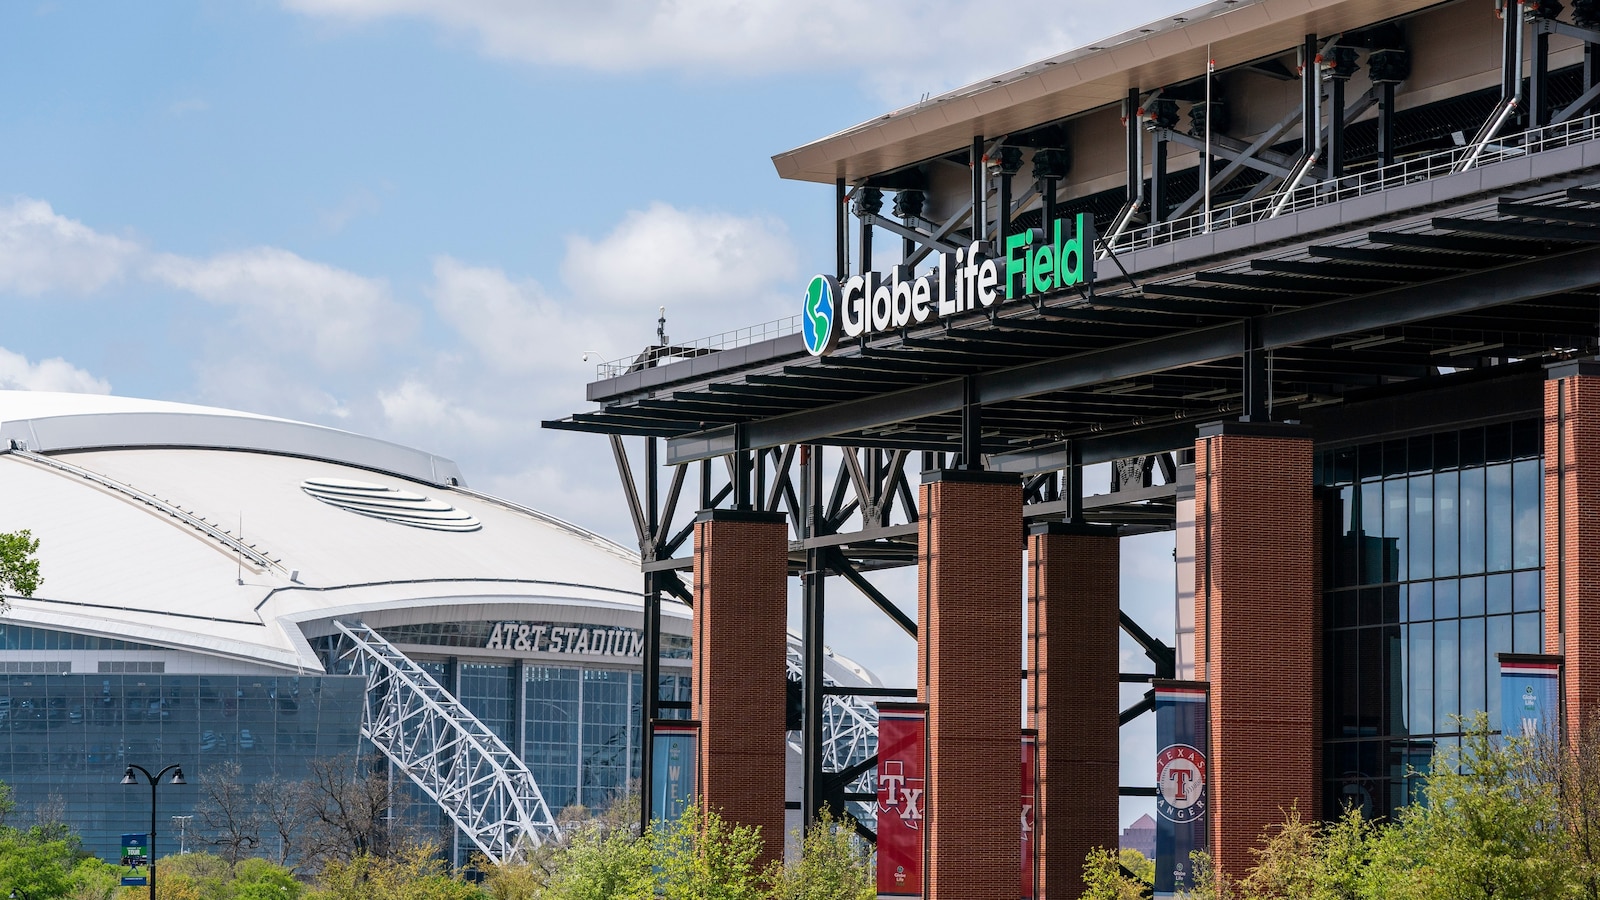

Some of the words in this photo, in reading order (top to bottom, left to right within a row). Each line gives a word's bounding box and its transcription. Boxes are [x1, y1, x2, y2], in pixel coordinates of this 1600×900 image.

[841, 265, 931, 338] Globe
[939, 240, 998, 317] Life
[1006, 212, 1084, 300] Field
[486, 622, 547, 651] AT&T
[1157, 748, 1206, 769] TEXAS
[880, 774, 923, 820] TX
[1169, 768, 1194, 801] T
